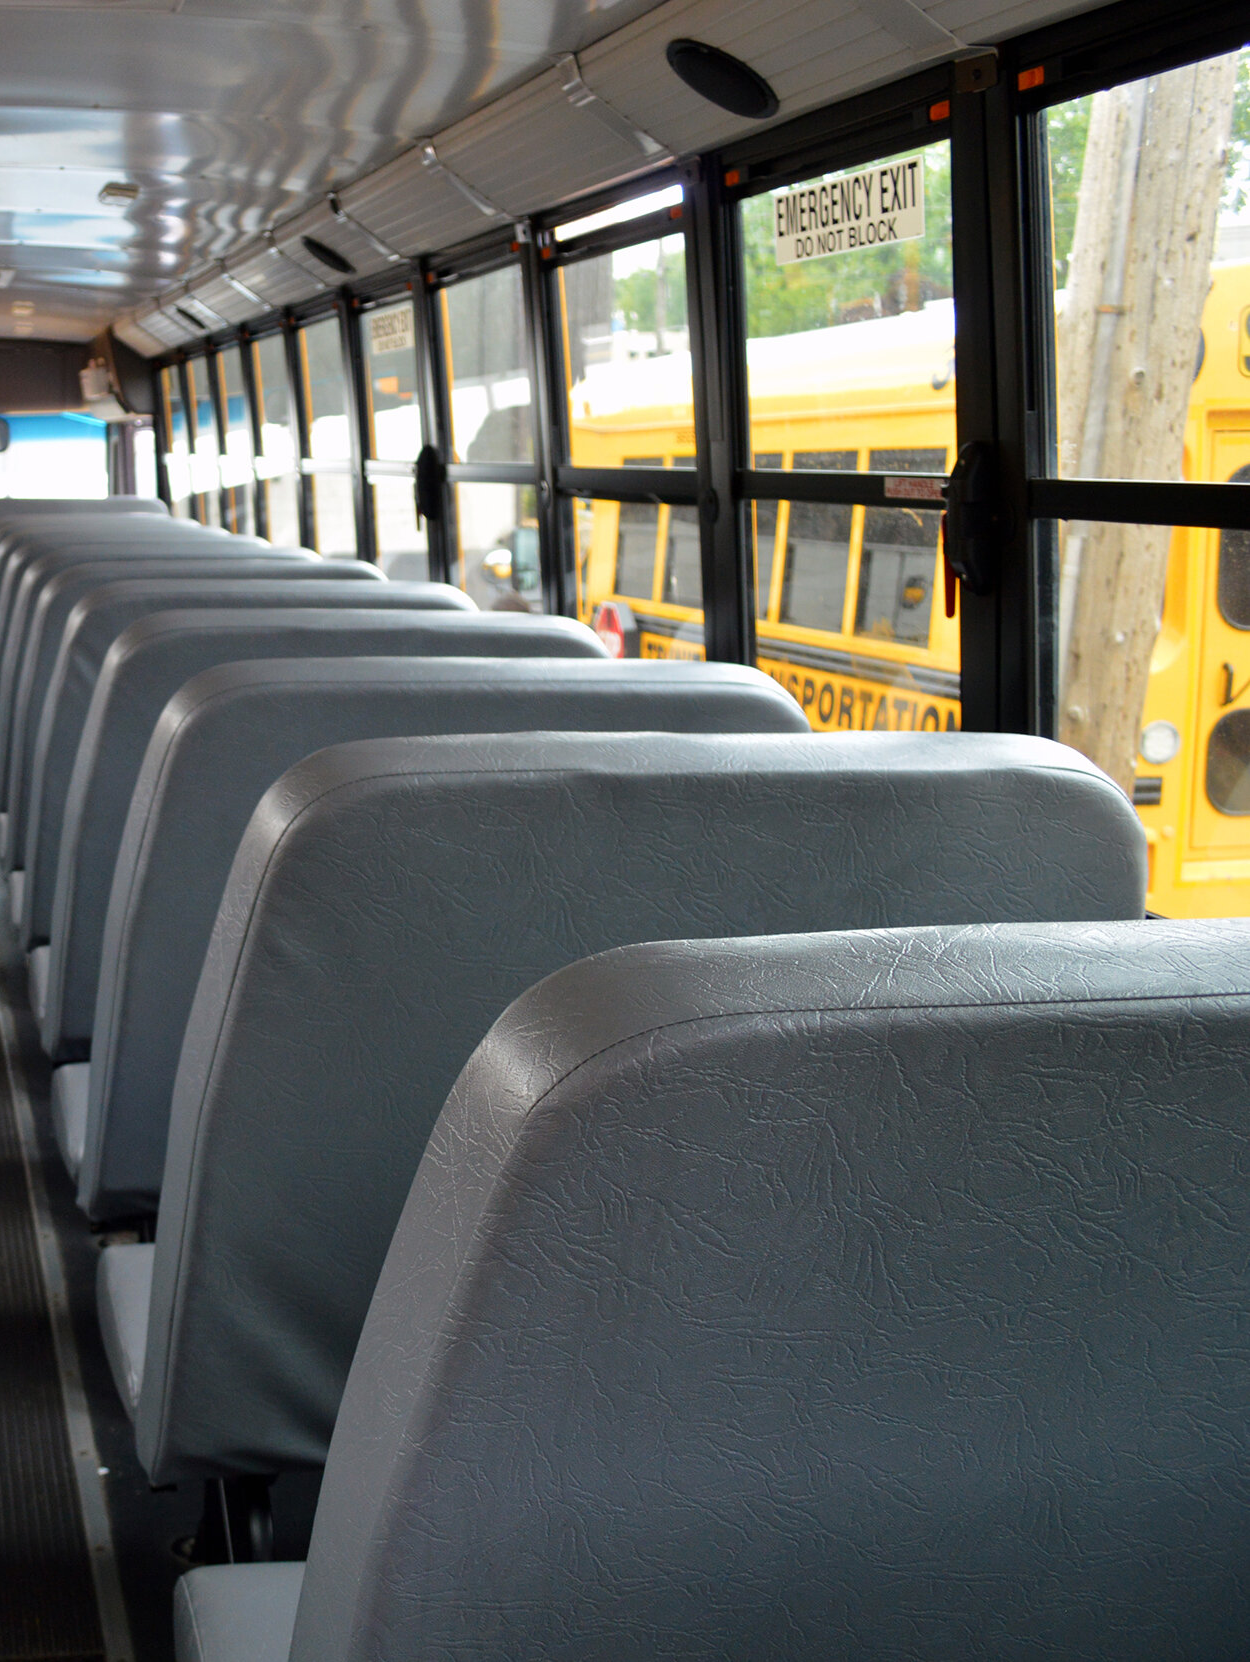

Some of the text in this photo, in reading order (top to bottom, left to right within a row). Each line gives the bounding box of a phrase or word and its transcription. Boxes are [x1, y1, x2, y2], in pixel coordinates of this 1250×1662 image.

[776, 161, 918, 238] EMERGENCY EXIT
[795, 217, 898, 259] DO NOT BLOCK
